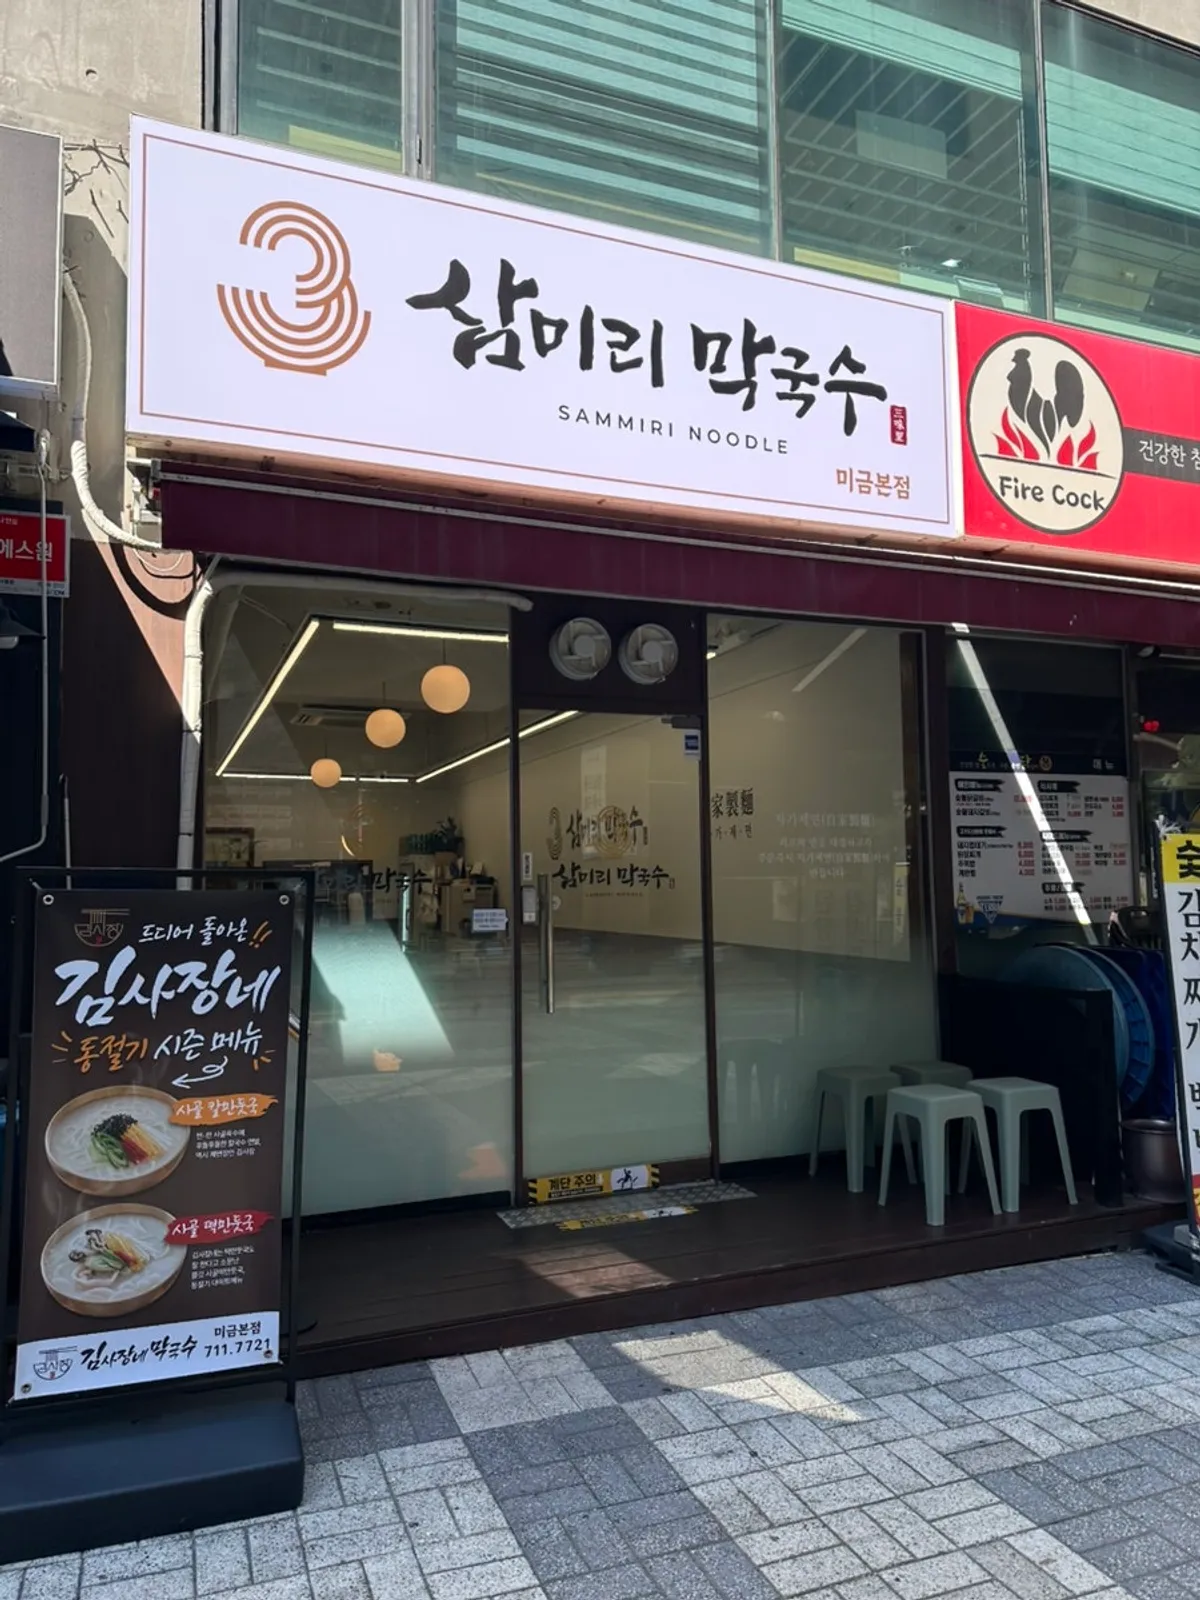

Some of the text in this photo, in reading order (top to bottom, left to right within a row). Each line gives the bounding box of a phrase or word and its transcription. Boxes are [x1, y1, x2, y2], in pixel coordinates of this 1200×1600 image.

[405, 258, 887, 436] 삼미리 막국수
[558, 404, 789, 454] SAMMIRI NOODLE
[1139, 440, 1187, 468] 건강한
[835, 468, 910, 500] 미금본점
[999, 476, 1105, 511] Fire Cock
[552, 862, 610, 889] 삼미리
[617, 864, 669, 889] 막국수
[139, 923, 193, 943] 드디어
[55, 945, 281, 1027] 김사장네
[74, 1021, 263, 1073] 동절기 시즌 메뉴
[176, 1100, 203, 1119] 사골
[549, 1173, 596, 1190] 계단 주의
[172, 1219, 199, 1238] 사골
[214, 1321, 262, 1338] 미금본점
[80, 1335, 198, 1371] 김사장네 막국수
[203, 1337, 272, 1359] 711.7721
